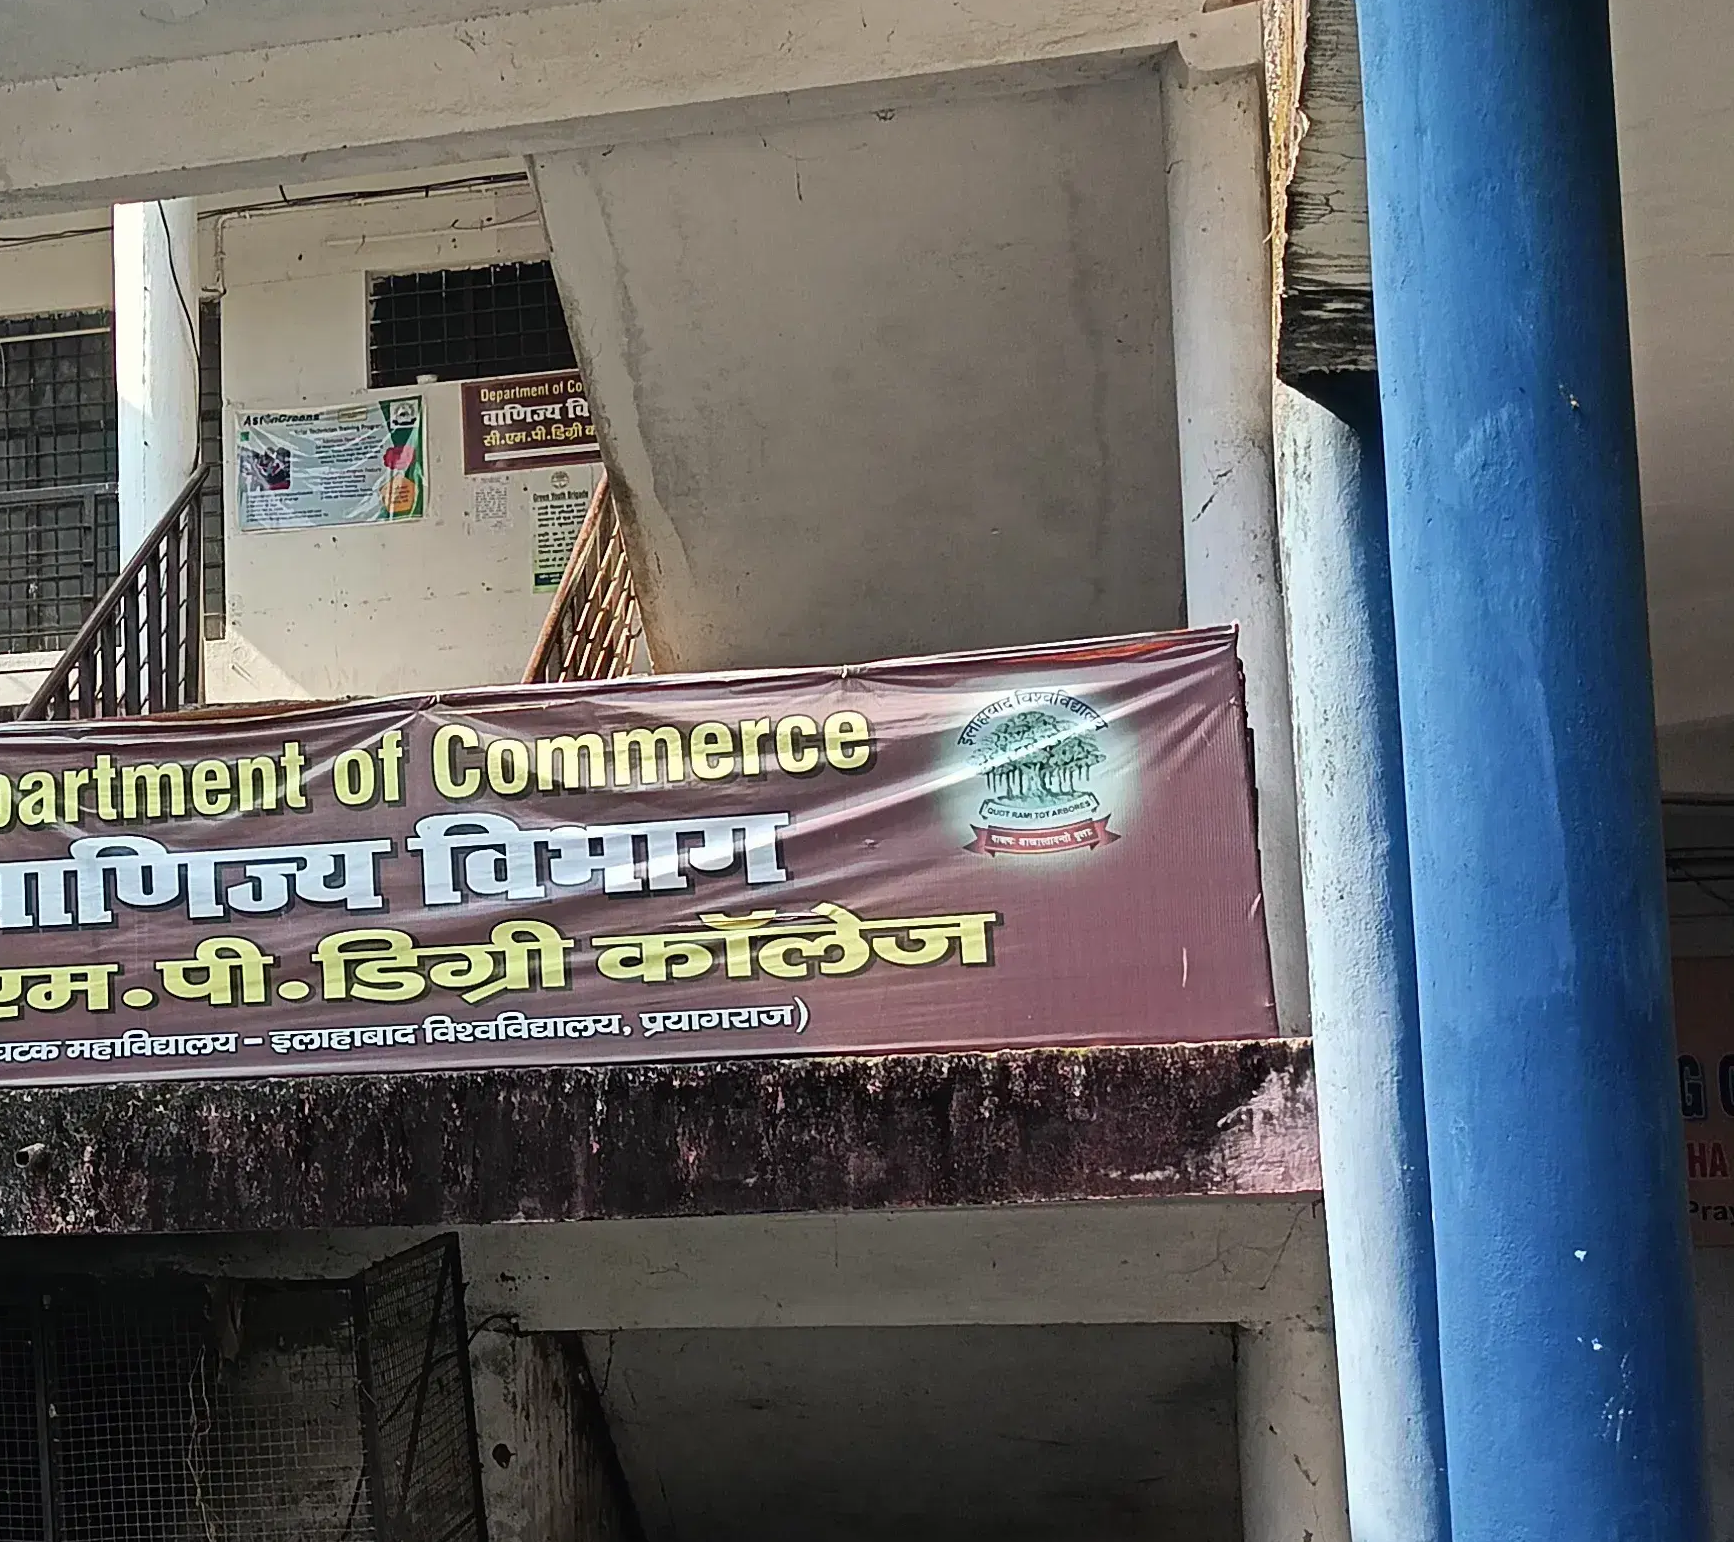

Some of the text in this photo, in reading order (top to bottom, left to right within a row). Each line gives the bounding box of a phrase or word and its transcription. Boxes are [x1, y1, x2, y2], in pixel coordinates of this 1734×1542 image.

[480, 382, 550, 404] Department
[552, 381, 564, 396] of
[481, 402, 564, 427] वाणिज्य
[334, 730, 403, 805] of
[433, 710, 871, 799] Commerce
[407, 811, 790, 906] विभाग
[592, 902, 997, 983] कॉलेज
[65, 1029, 239, 1061] महाविद्यालय
[269, 1024, 419, 1054] इलाहाबाद
[422, 1011, 633, 1044] विश्वविद्यालय,
[639, 996, 810, 1037] प्रयागराज)
